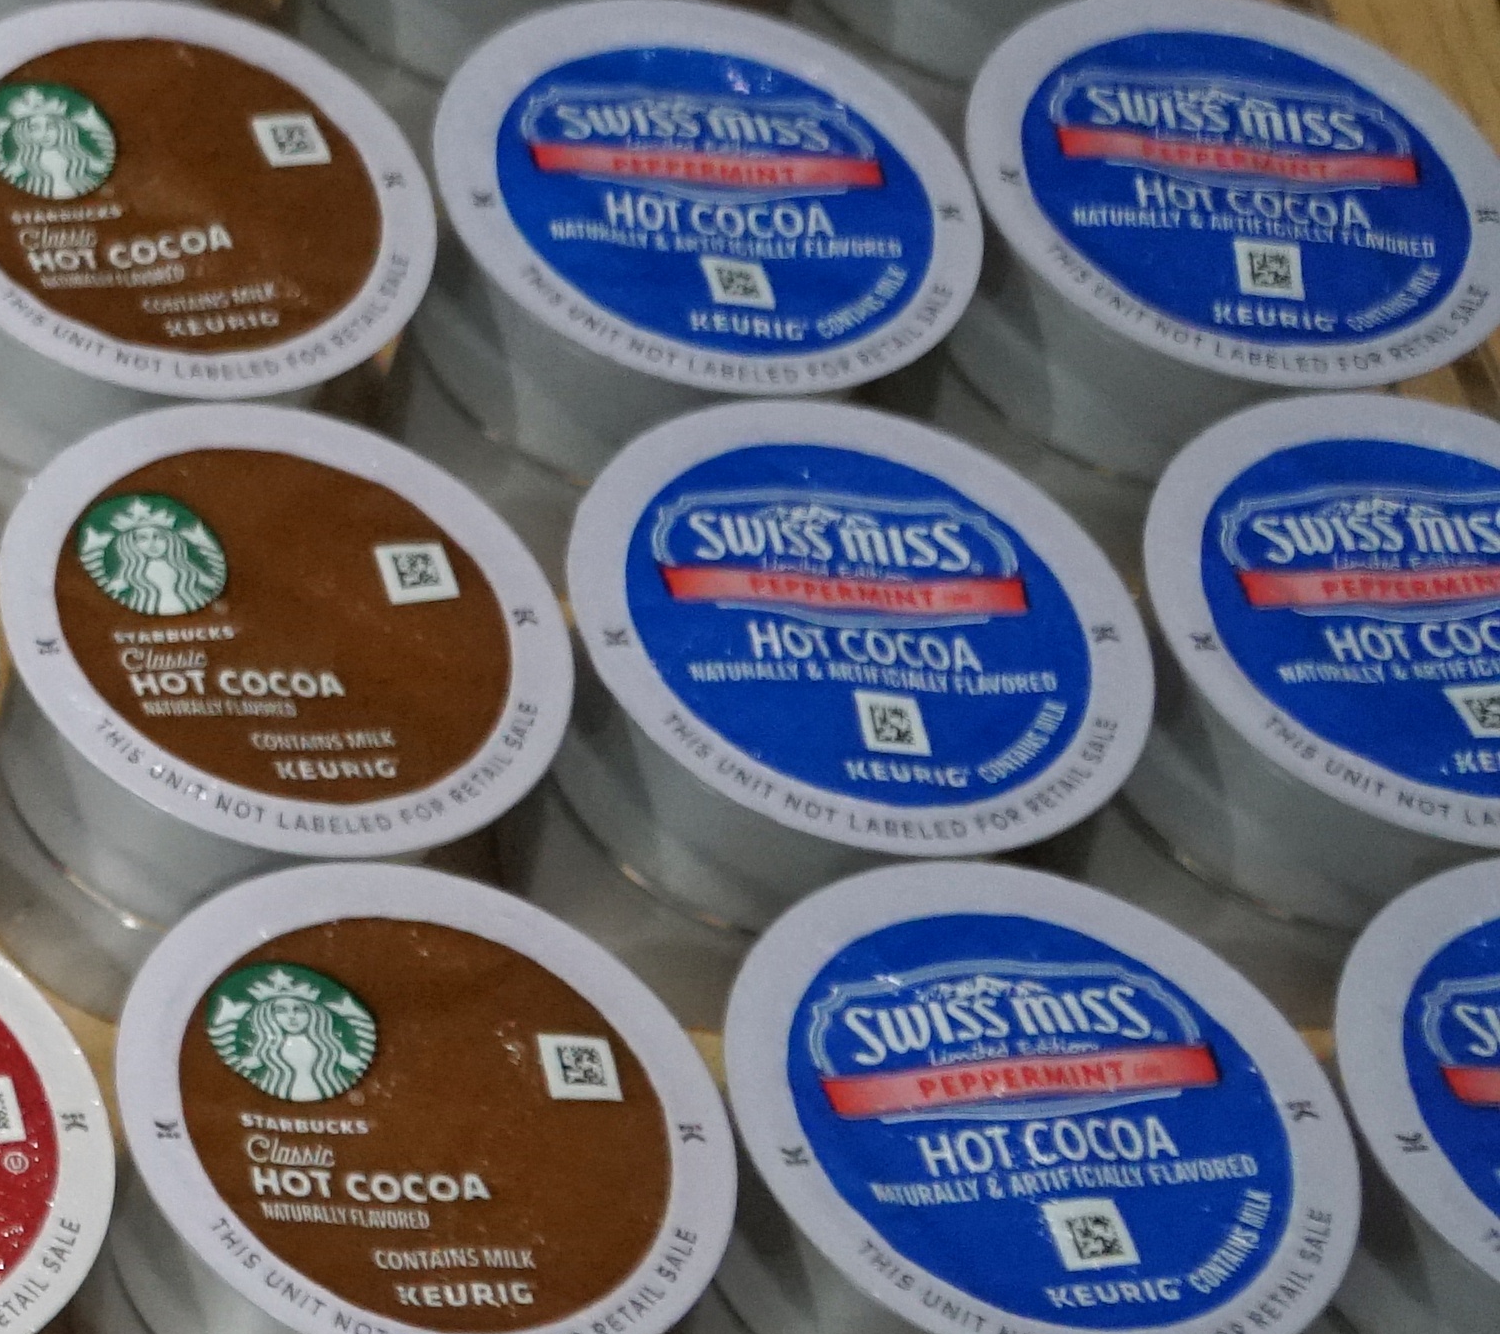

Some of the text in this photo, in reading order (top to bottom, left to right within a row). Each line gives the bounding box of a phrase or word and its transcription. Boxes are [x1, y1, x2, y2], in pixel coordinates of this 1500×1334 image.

[604, 191, 834, 239] HOT COCOA
[747, 620, 980, 671] HOT COCOA
[130, 669, 347, 699] HOT COCOA
[917, 1062, 1125, 1102] PEPPERMINT
[239, 1112, 368, 1136] STARBUCKS
[918, 1119, 1180, 1176] HOT COCOA
[250, 1165, 490, 1204] HOT COCOA
[373, 1246, 535, 1273] CONTAINS MILK
[395, 1281, 534, 1310] KEURIG
